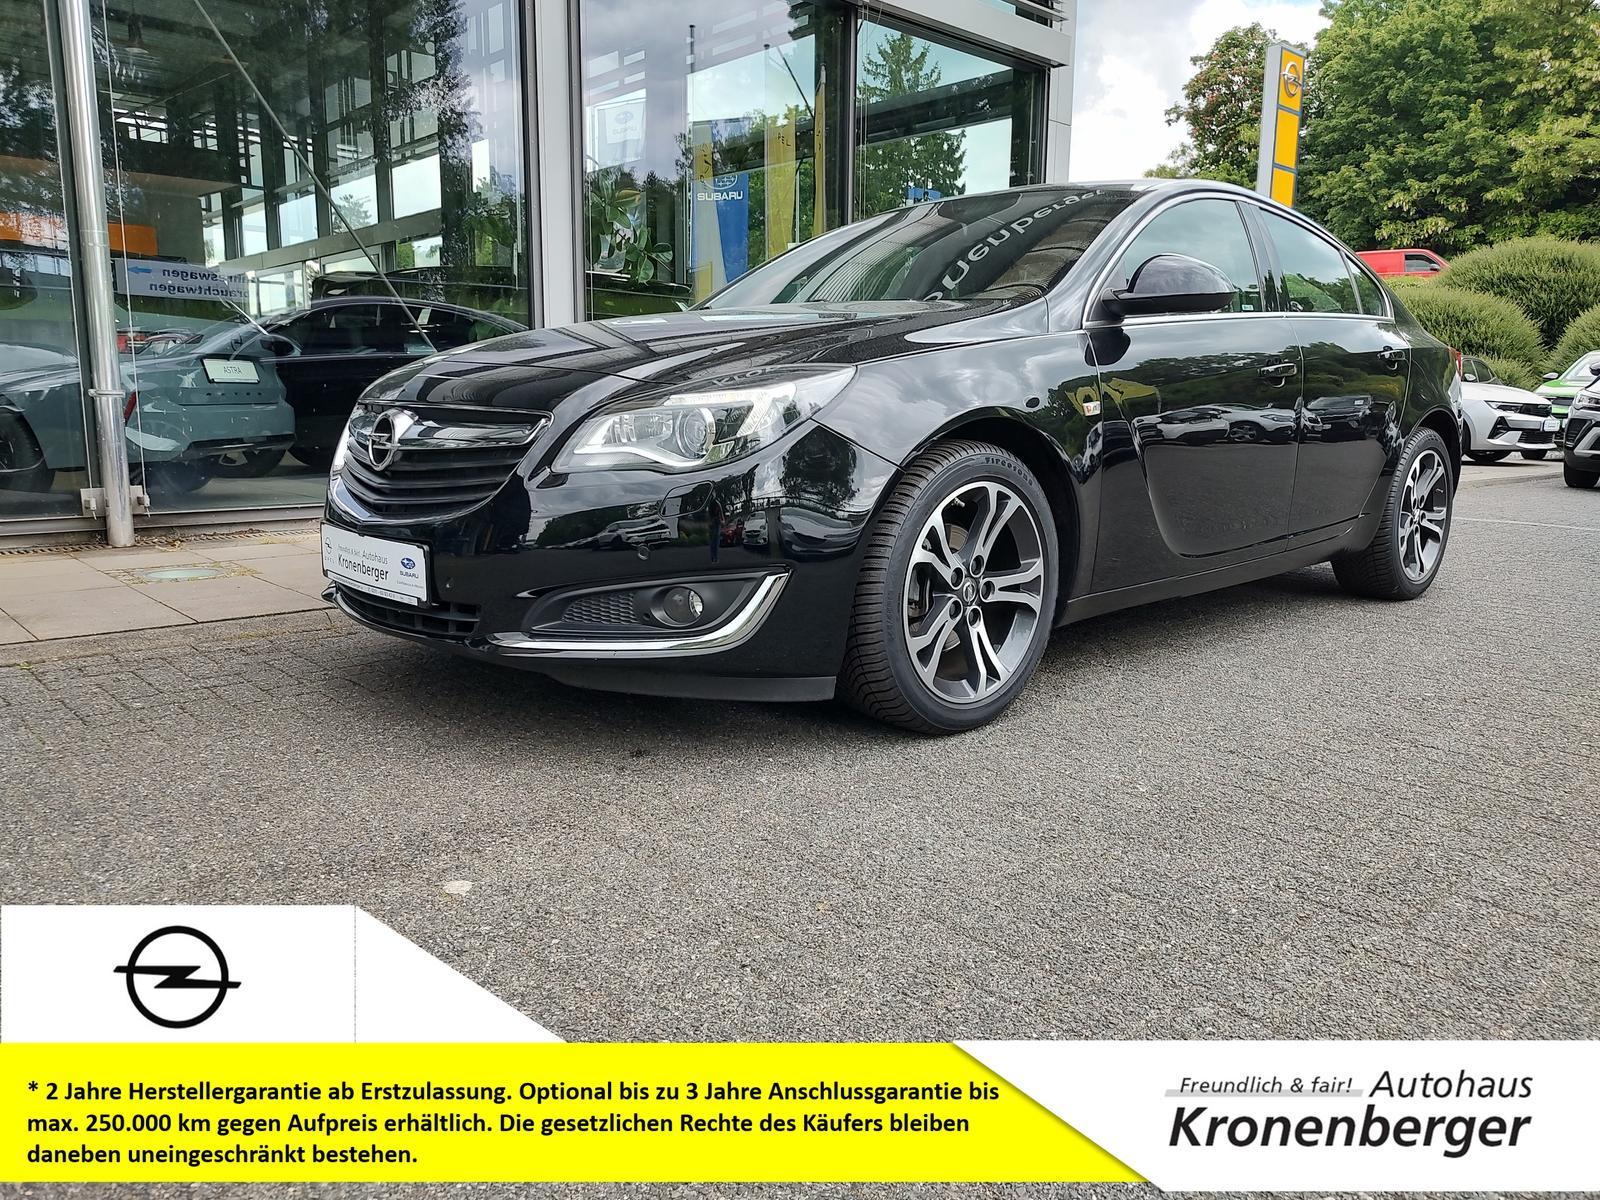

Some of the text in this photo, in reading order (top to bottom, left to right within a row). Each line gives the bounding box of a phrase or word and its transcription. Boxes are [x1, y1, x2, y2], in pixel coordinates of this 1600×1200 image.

[697, 190, 743, 201] SUBARU
[361, 549, 388, 565] Autohaus
[338, 553, 389, 582] Kronenberger
